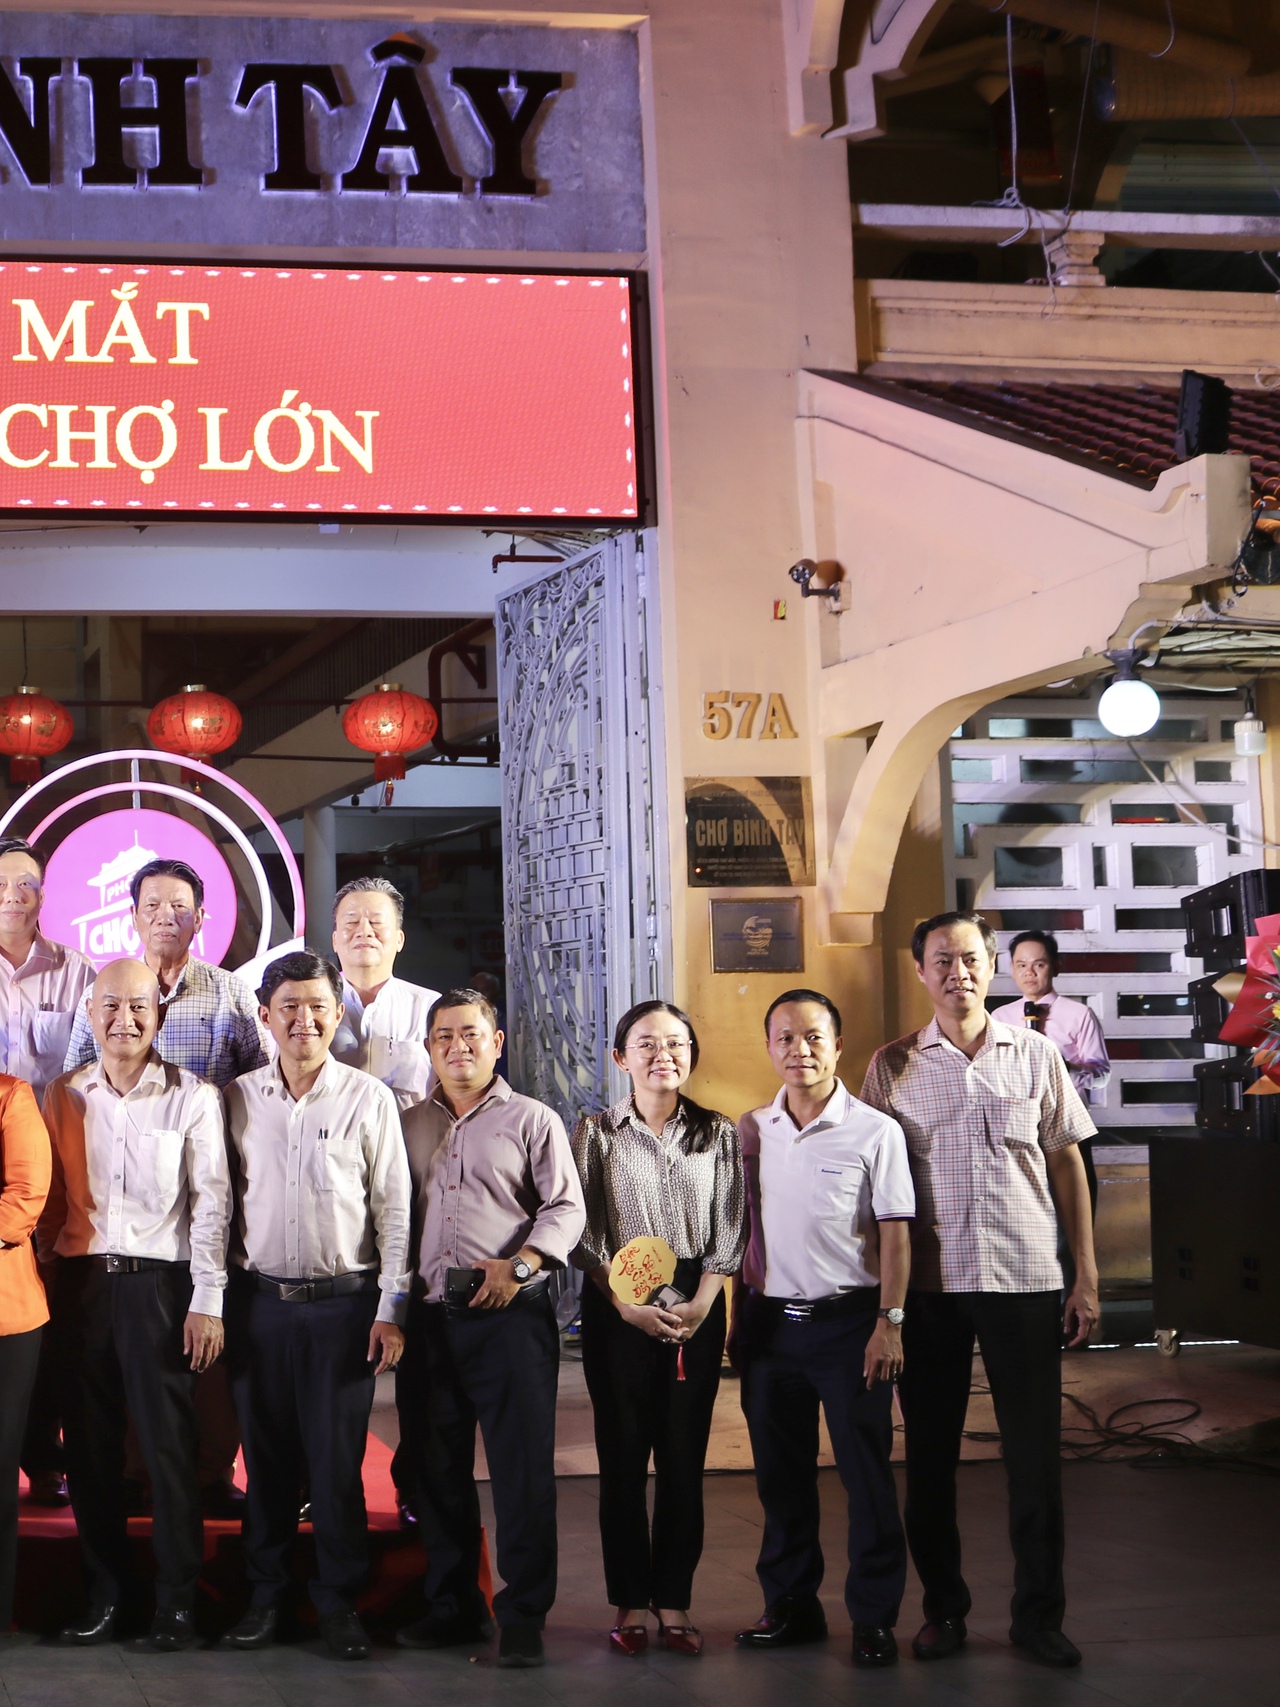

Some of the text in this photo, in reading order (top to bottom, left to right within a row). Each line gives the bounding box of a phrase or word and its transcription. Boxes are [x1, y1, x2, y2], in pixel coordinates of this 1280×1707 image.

[234, 31, 563, 198] TÂY
[12, 282, 210, 364] MẮT
[198, 390, 380, 474] LỚN
[702, 690, 799, 740] 57A
[695, 813, 806, 852] CHỢ BÌNH TÂY
